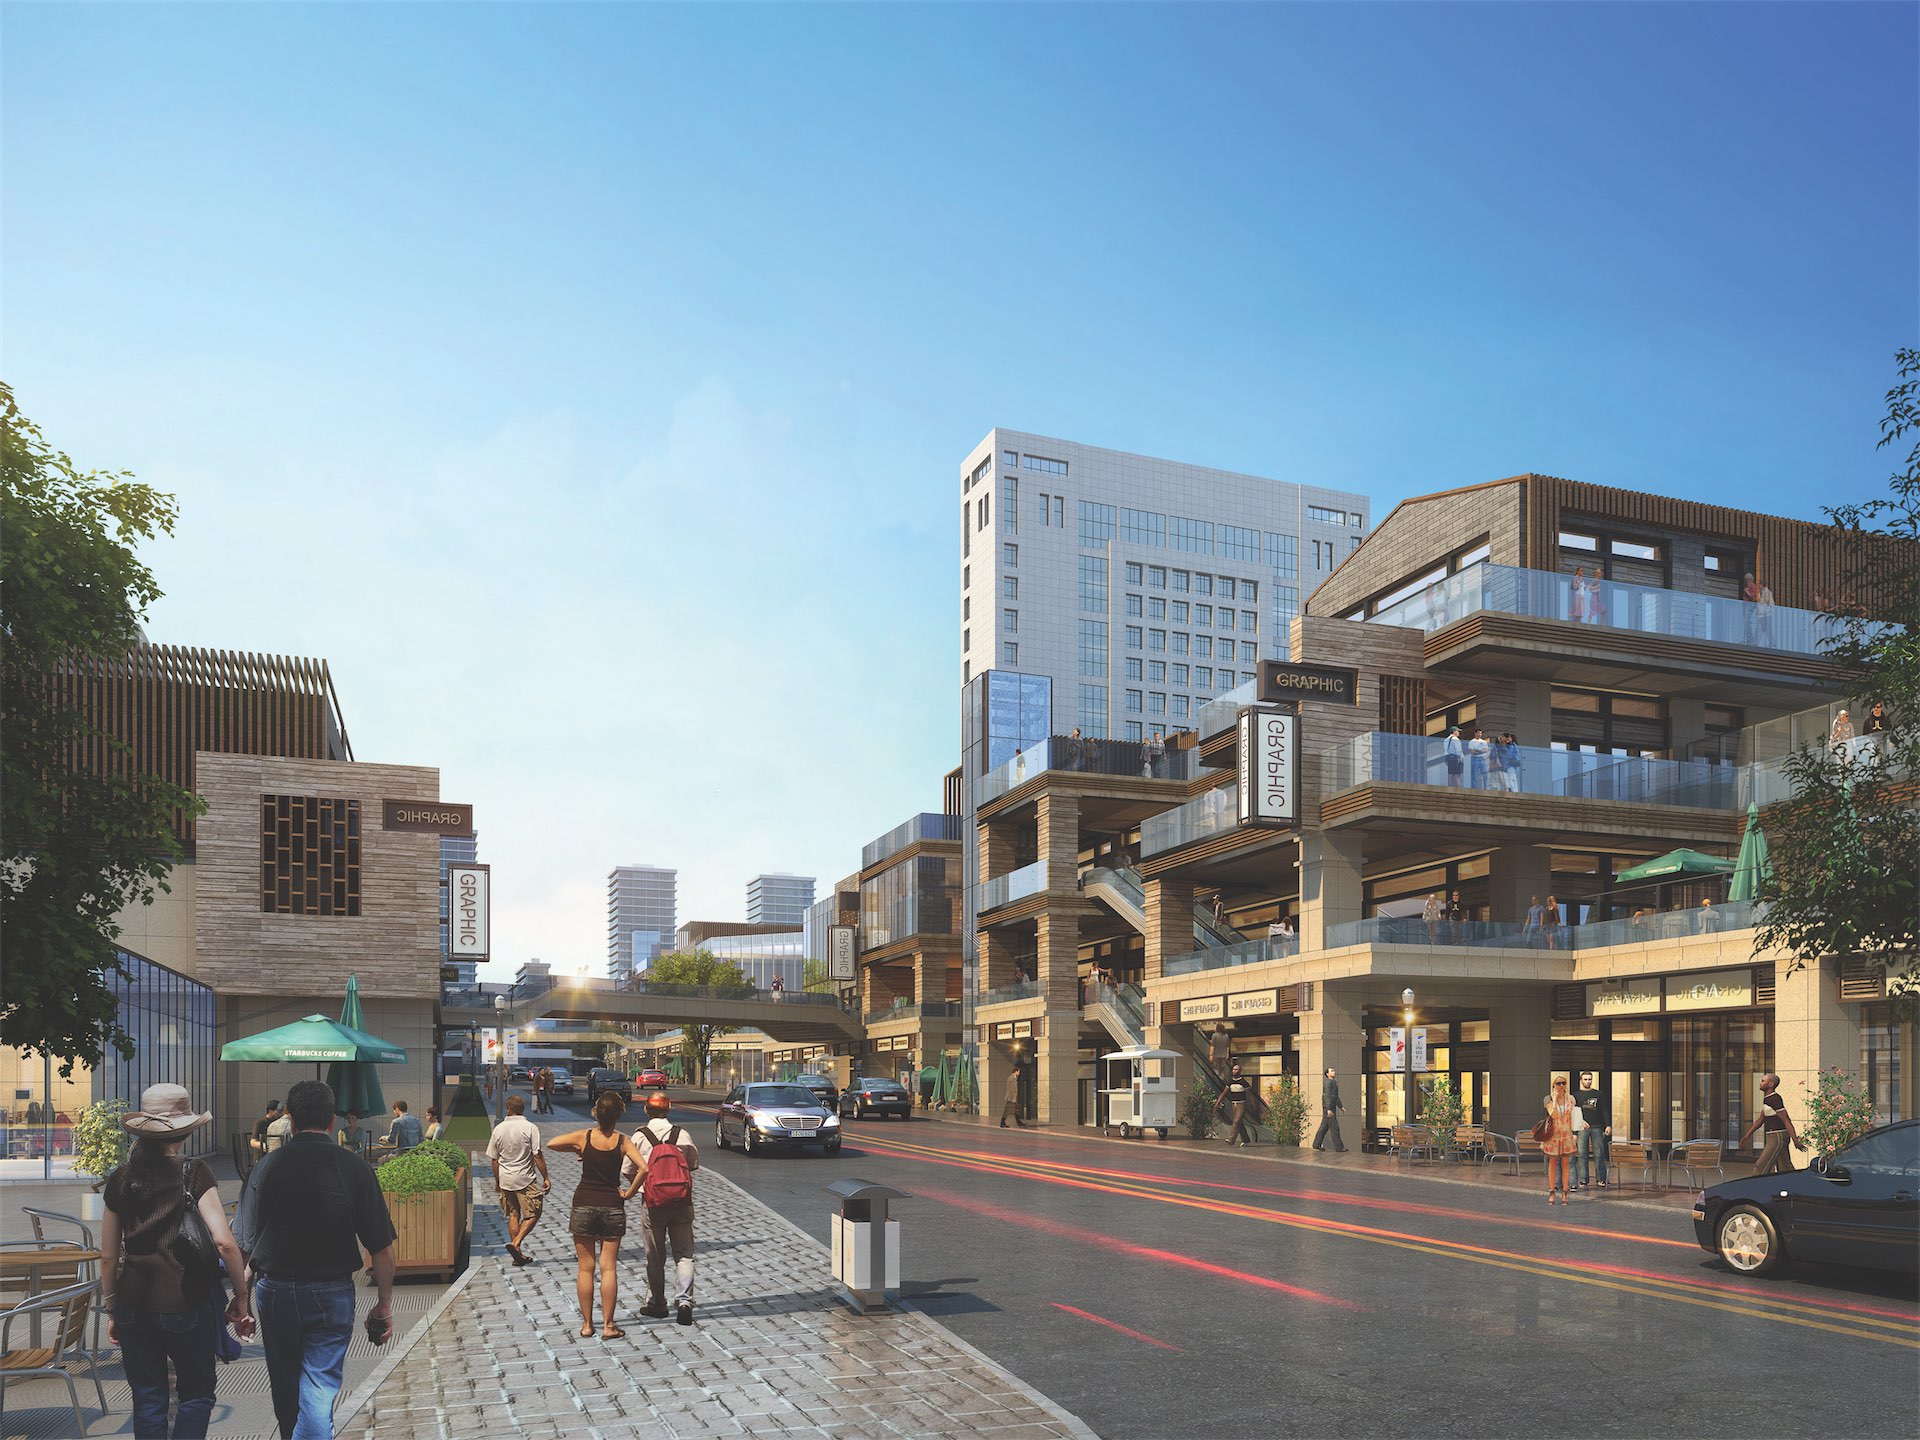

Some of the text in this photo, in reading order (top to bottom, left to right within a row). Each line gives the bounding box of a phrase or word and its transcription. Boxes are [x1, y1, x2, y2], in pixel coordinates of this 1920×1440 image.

[1276, 673, 1344, 693] GRAPHIC
[460, 874, 477, 946] GRAPHIC
[323, 1050, 347, 1058] COFFEE
